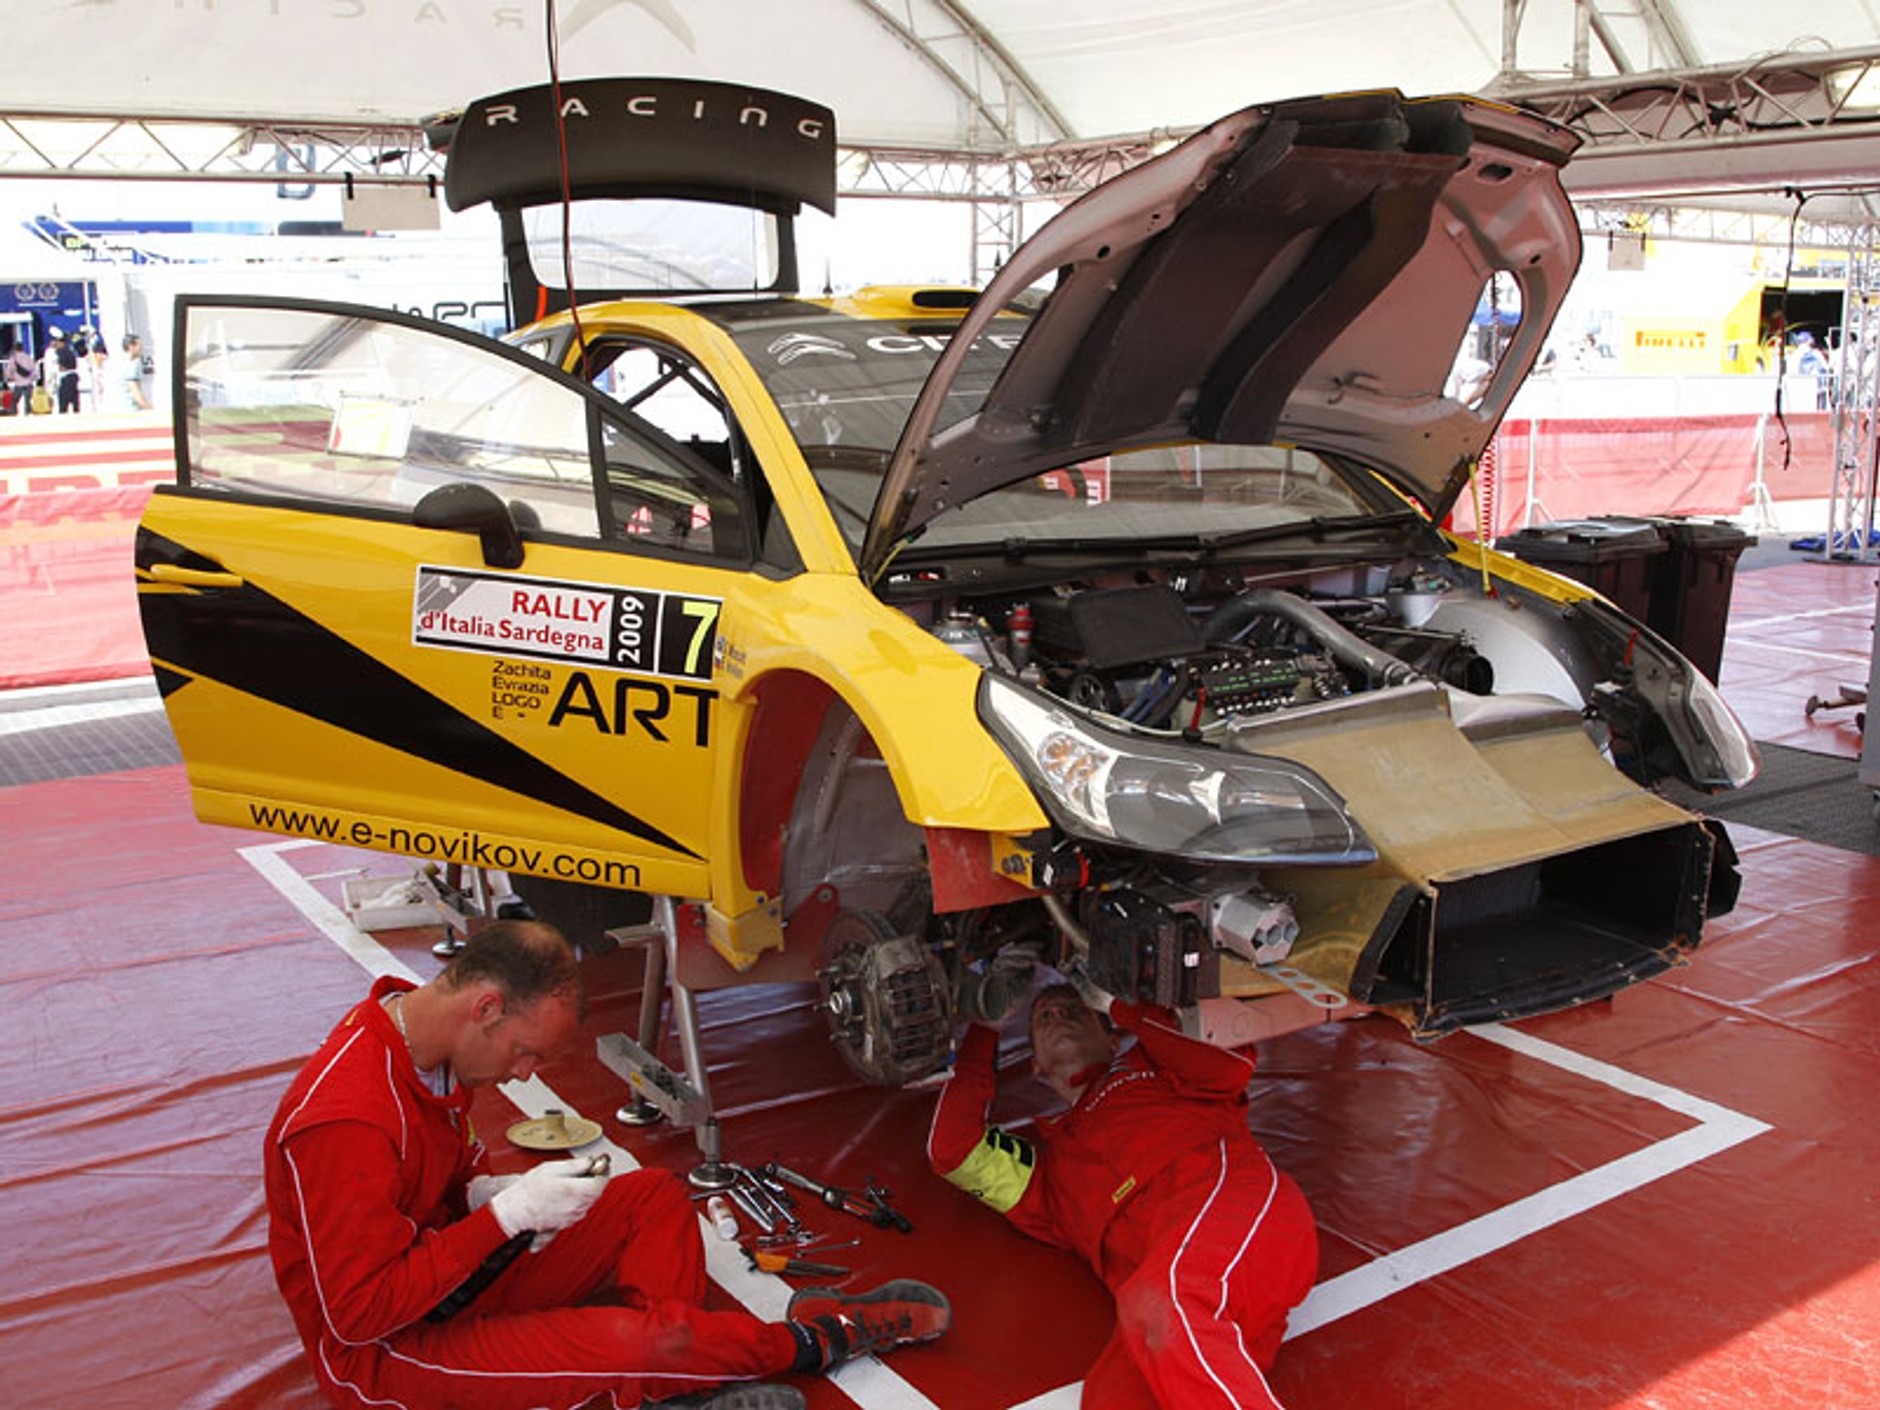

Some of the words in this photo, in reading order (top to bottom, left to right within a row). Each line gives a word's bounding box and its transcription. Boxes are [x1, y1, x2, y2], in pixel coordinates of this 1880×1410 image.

[484, 96, 824, 138] RACING
[511, 590, 607, 623] RALLY
[420, 610, 495, 637] d'Italia
[498, 619, 604, 652] Sardegna
[616, 596, 645, 664] 2009
[681, 600, 719, 675] 7
[491, 675, 550, 695] Evrazia
[492, 660, 552, 680] Zachita
[491, 691, 542, 710] LOGO
[548, 671, 720, 748] ART
[249, 803, 642, 887] www.e-novikov.com
